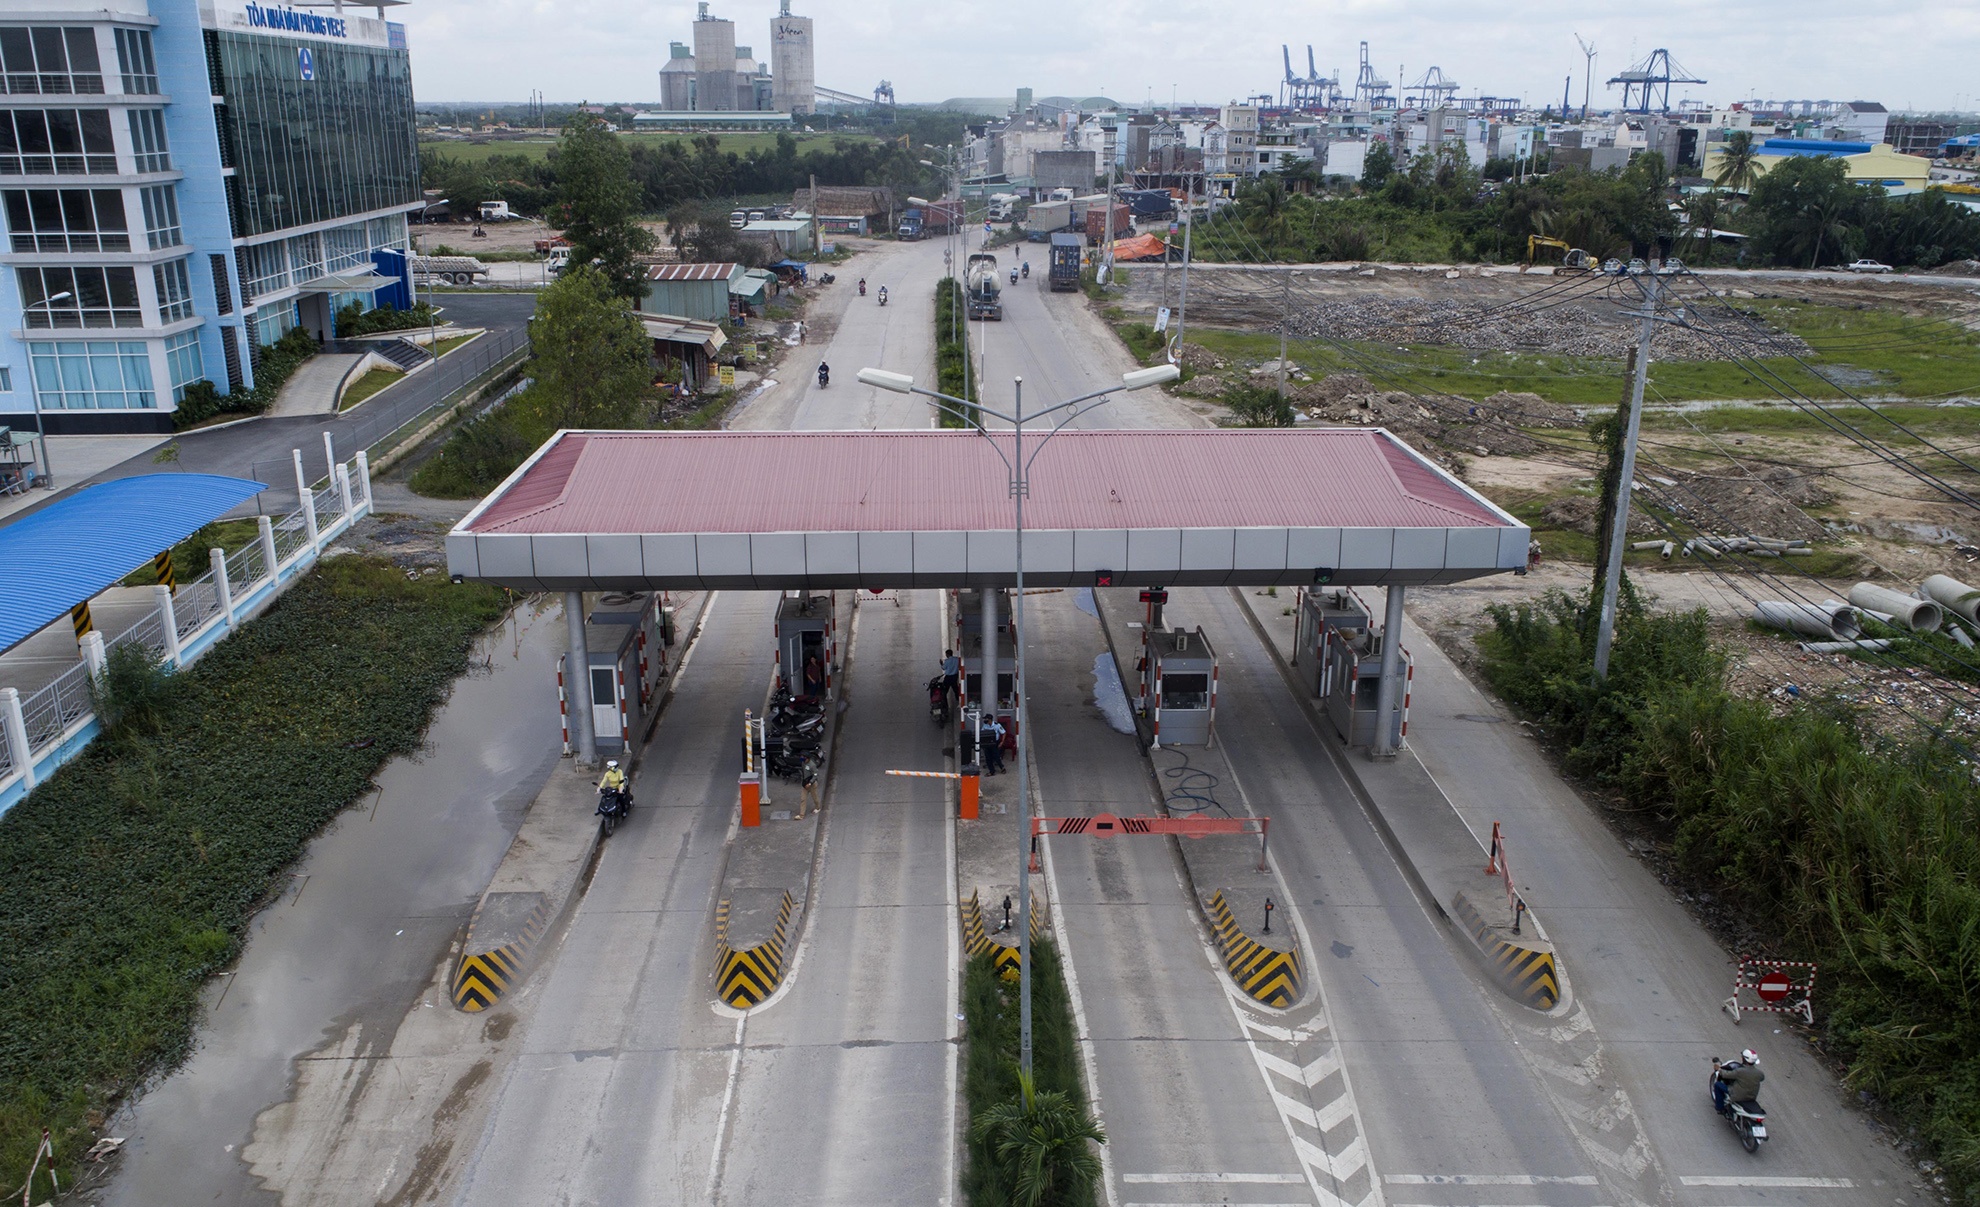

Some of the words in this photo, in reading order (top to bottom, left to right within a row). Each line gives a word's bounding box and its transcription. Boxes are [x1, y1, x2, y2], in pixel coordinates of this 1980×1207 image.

[246, 1, 267, 27] TÒA
[266, 5, 286, 29] NHÀ
[283, 6, 300, 32] VĂN
[300, 10, 326, 35] PHÒNG
